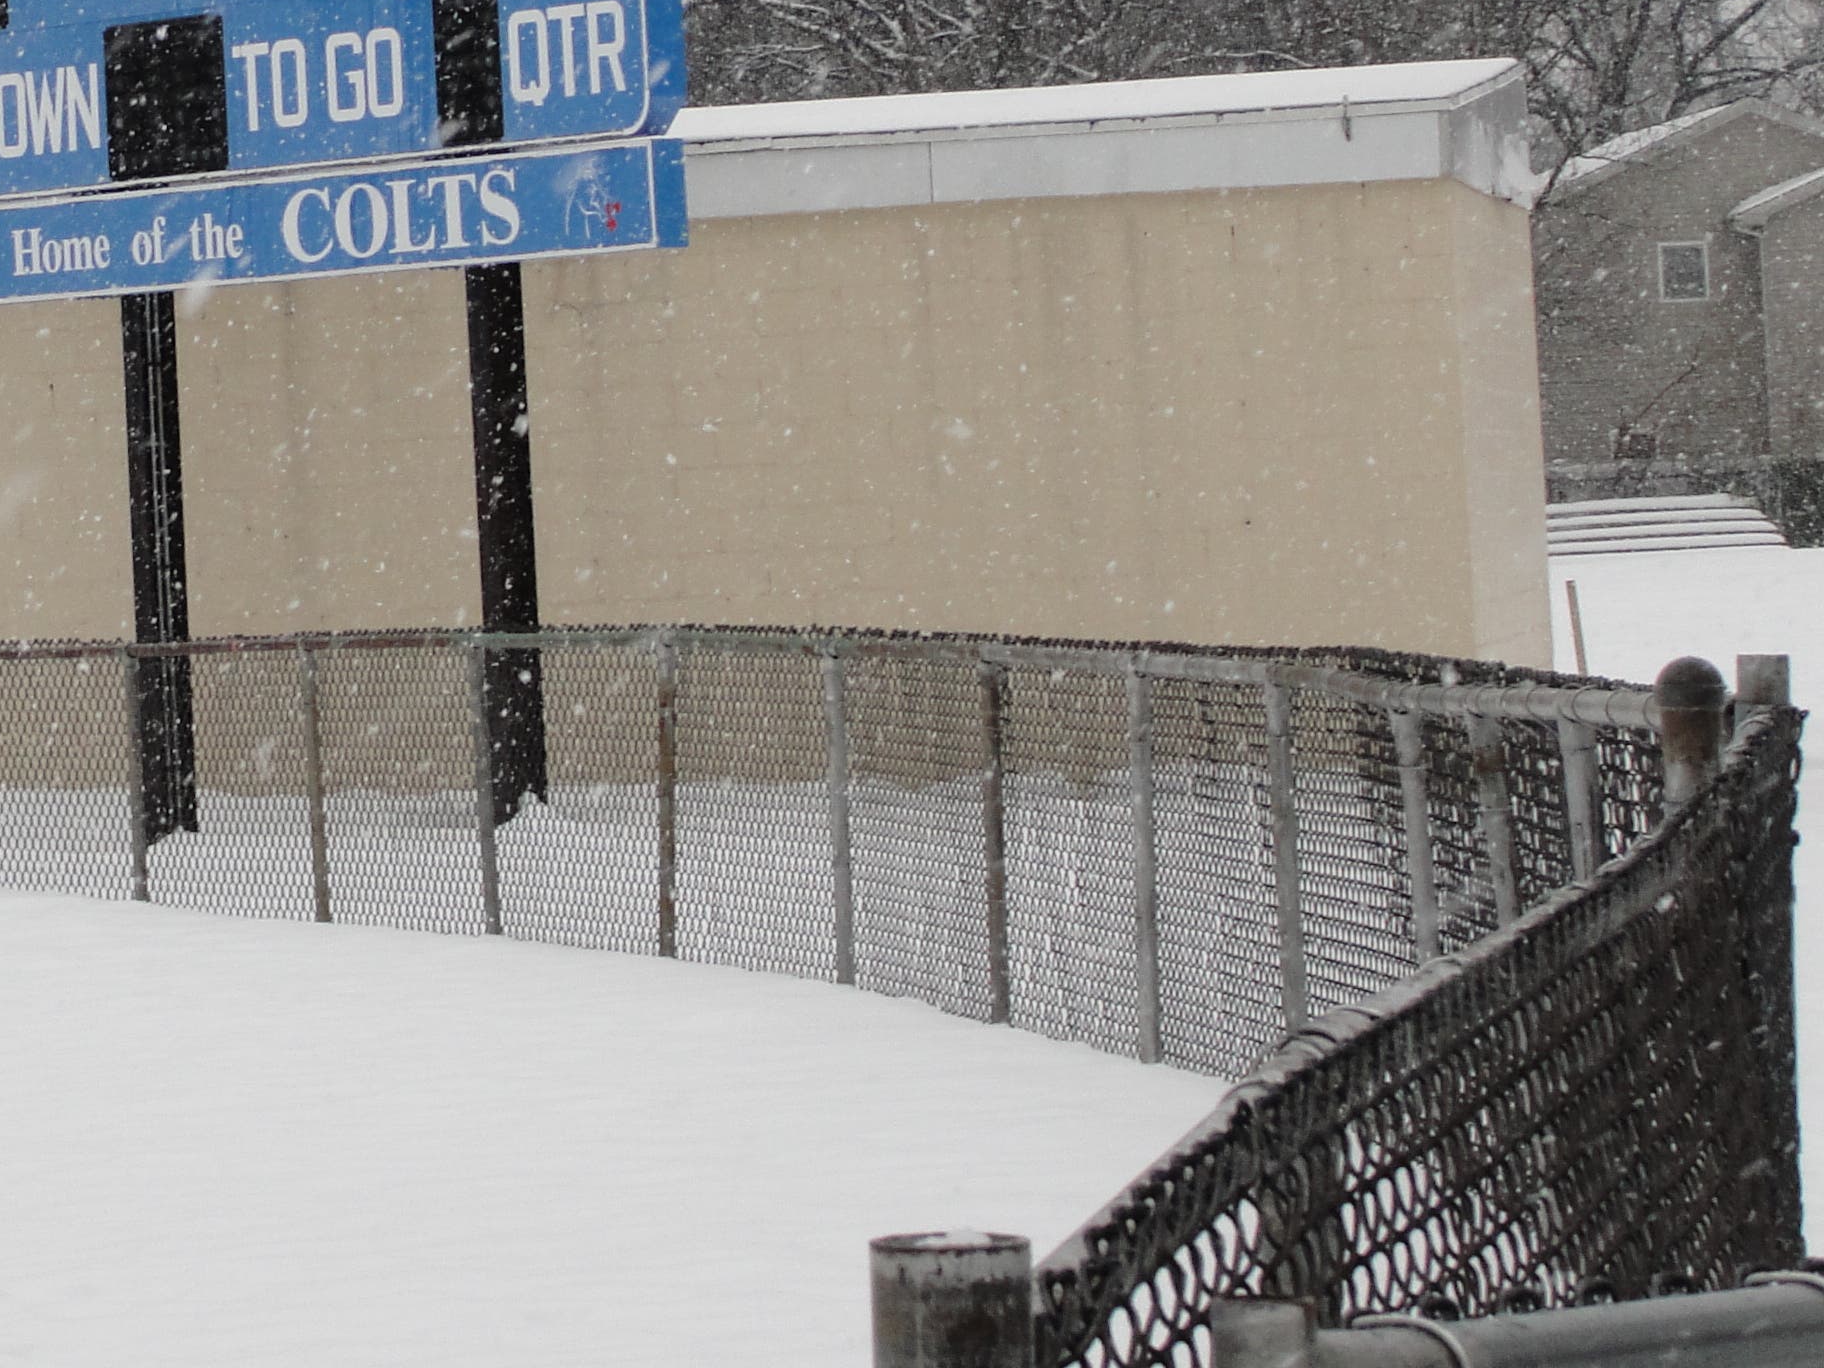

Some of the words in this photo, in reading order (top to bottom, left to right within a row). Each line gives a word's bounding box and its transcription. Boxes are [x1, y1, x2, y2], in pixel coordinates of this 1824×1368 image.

[231, 38, 308, 132] TO
[325, 27, 403, 123] GO
[507, 0, 626, 107] QTR
[11, 227, 111, 276] Home
[132, 217, 166, 265] of
[190, 213, 244, 262] the
[282, 168, 521, 263] COLTS
